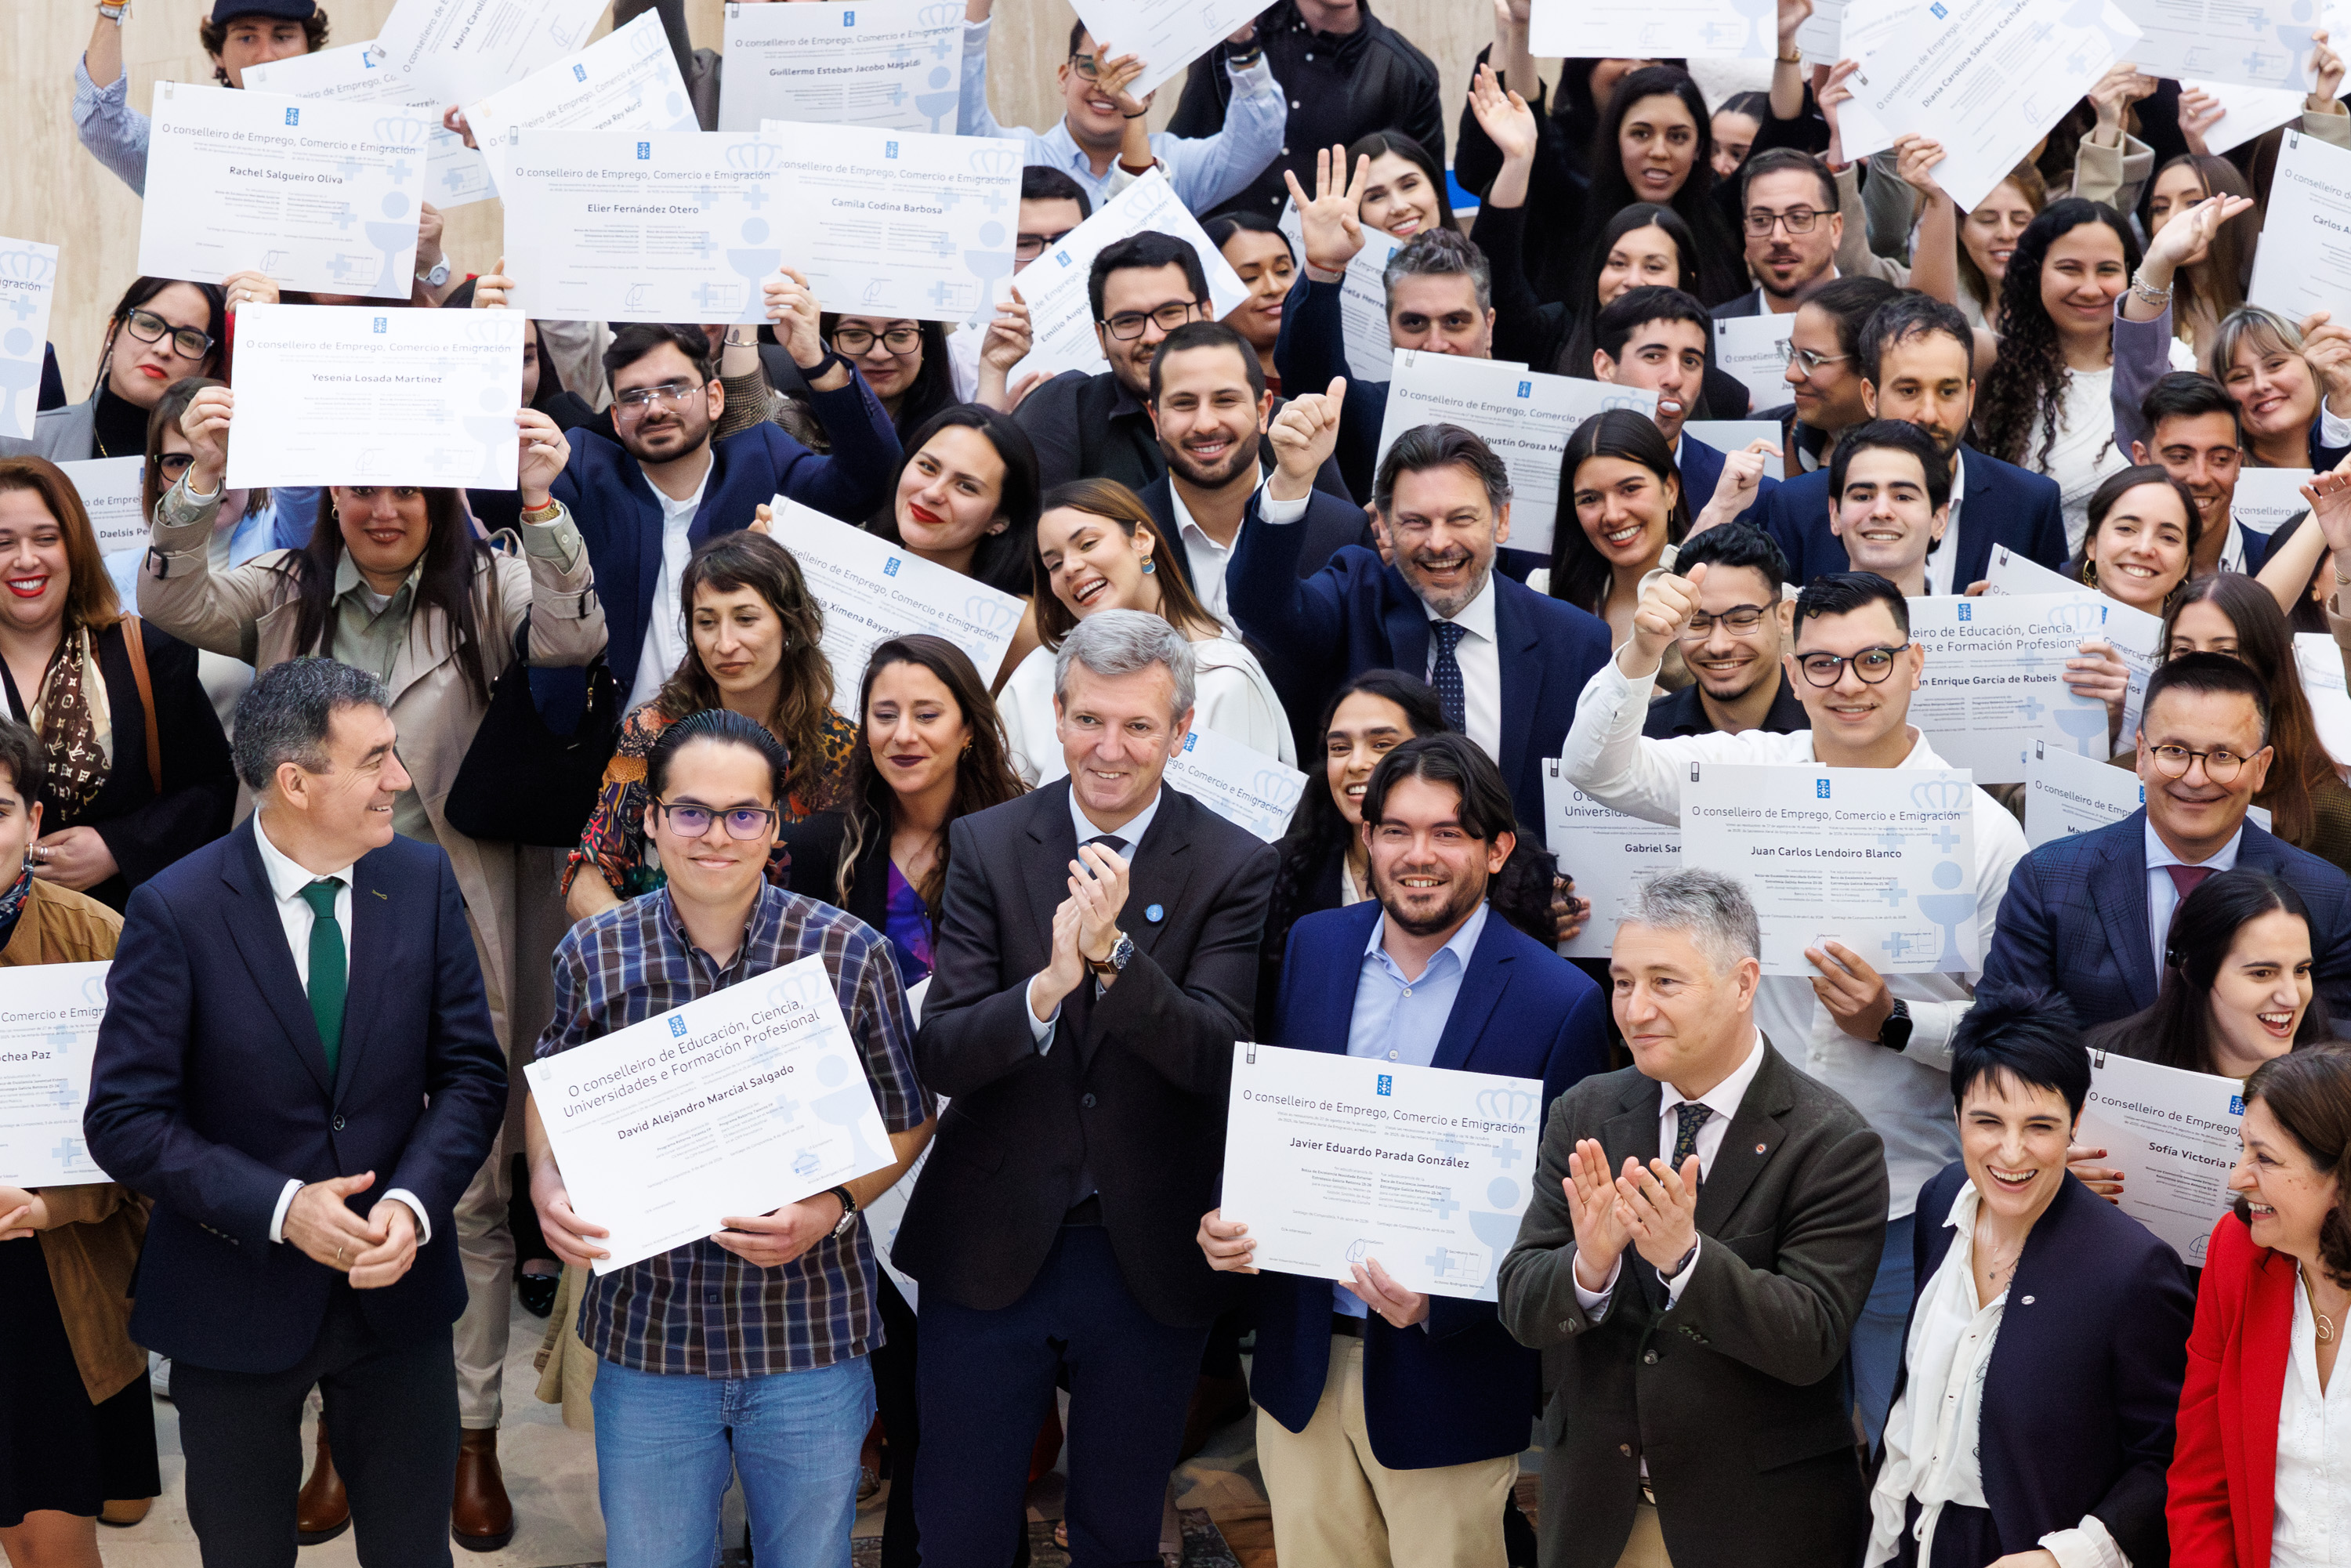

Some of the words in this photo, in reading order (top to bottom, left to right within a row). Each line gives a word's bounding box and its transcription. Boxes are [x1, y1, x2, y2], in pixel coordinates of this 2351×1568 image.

[734, 38, 742, 47] O
[744, 38, 795, 47] conselleiro
[797, 37, 809, 45] de
[811, 37, 854, 45] Emprego,
[856, 33, 897, 42] Comercio
[855, 63, 885, 72] Jacobo
[1922, 86, 1943, 107] Diana
[1941, 56, 1971, 86] Carolina
[1969, 28, 1998, 57] Sánchez
[161, 123, 170, 132] O
[173, 126, 229, 139] conselleiro
[232, 131, 245, 140] de
[248, 132, 296, 147] Emprego,
[299, 137, 348, 150] Comercio
[360, 142, 415, 155] Emigración
[230, 166, 263, 177] Rachel
[266, 169, 314, 182] Salgueiro
[317, 174, 342, 183] Oliva
[516, 167, 523, 176] O
[527, 168, 583, 177] conselleiro
[585, 168, 598, 178] de
[602, 169, 650, 181] Emprego,
[653, 170, 701, 179] Comercio
[714, 170, 770, 182] Emigración
[835, 164, 847, 173] de
[849, 165, 896, 179] Emprego,
[899, 169, 946, 181] Comercio
[957, 173, 1010, 186] Emigración
[2284, 168, 2291, 177] O
[2293, 173, 2342, 196] conselleiro
[588, 204, 610, 212] Elier
[614, 204, 665, 213] Fernández
[831, 198, 864, 208] Camila
[868, 201, 900, 211] Codina
[904, 204, 942, 214] Barbosa
[2313, 215, 2341, 230] Carlos
[1040, 319, 1066, 342] Emilio
[246, 339, 255, 348] O
[257, 340, 316, 349] conselleiro
[319, 341, 331, 349] de
[335, 342, 385, 353] Emprego,
[389, 342, 439, 351] Comercio
[452, 343, 510, 354] Emigración
[1400, 388, 1407, 397] O
[1410, 392, 1463, 407] conselleiro
[1465, 400, 1478, 408] de
[1480, 402, 1526, 417] Emprego,
[1530, 408, 1575, 422] Comercio
[1518, 440, 1545, 450] Oroza
[100, 528, 133, 538] Daelsis
[829, 563, 841, 574] de
[843, 569, 887, 596] Emprego,
[891, 589, 936, 614] Comercio
[946, 613, 998, 642] Emigración
[829, 602, 864, 622] Ximena
[1940, 626, 1954, 637] de
[1959, 625, 2023, 636] Educación,
[2028, 624, 2074, 634] Ciencia,
[1947, 639, 2012, 651] Formación
[2016, 636, 2085, 650] Profesional
[1931, 676, 1969, 686] Enrique
[2023, 673, 2056, 682] Rubeis
[1188, 765, 1227, 790] Comercio
[1236, 788, 1282, 814] Emigración
[2035, 780, 2041, 789] O
[2044, 784, 2092, 806] conselleiro
[2094, 799, 2105, 809] de
[1692, 806, 1700, 815] O
[1703, 806, 1761, 817] conselleiro
[1765, 808, 1777, 817] de
[1780, 809, 1831, 822] Emprego,
[1835, 809, 1886, 820] Comercio
[1899, 810, 1960, 823] Emigración
[1625, 843, 1662, 852] Gabriel
[1751, 846, 1775, 855] Juan
[1778, 846, 1812, 856] Carlos
[1815, 848, 1862, 857] Lendoiro
[1865, 849, 1901, 857] Blanco
[1, 1009, 56, 1022] Comercio
[31, 1050, 50, 1059] Paz
[568, 1085, 579, 1096] O
[583, 1057, 655, 1092] conselleiro
[659, 1048, 675, 1062] de
[677, 1022, 748, 1054] Educación,
[751, 1000, 803, 1024] Ciencia,
[563, 1075, 657, 1117] Universidades
[660, 1070, 668, 1080] e
[671, 1041, 741, 1075] Formación
[743, 1008, 820, 1046] Profesional
[618, 1120, 649, 1139] David
[652, 1100, 705, 1126] Alejandro
[706, 1081, 748, 1104] Marcial
[749, 1065, 793, 1088] Salgado
[2089, 1092, 2099, 1101] O
[2101, 1096, 2164, 1117] conselleiro
[2168, 1110, 2182, 1121] de
[1243, 1089, 1252, 1099] O
[1255, 1093, 1316, 1108] conselleiro
[1319, 1099, 1332, 1110] de
[1336, 1102, 1389, 1120] Emprego,
[1393, 1109, 1447, 1125] Comercio
[1462, 1117, 1525, 1133] Emigración
[1289, 1137, 1323, 1150] Javier
[1326, 1142, 1371, 1157] Eduardo
[1375, 1148, 1413, 1161] Parada
[1417, 1153, 1469, 1168] González
[2148, 1142, 2177, 1156] Sofía
[2181, 1150, 2226, 1168] Victoria
